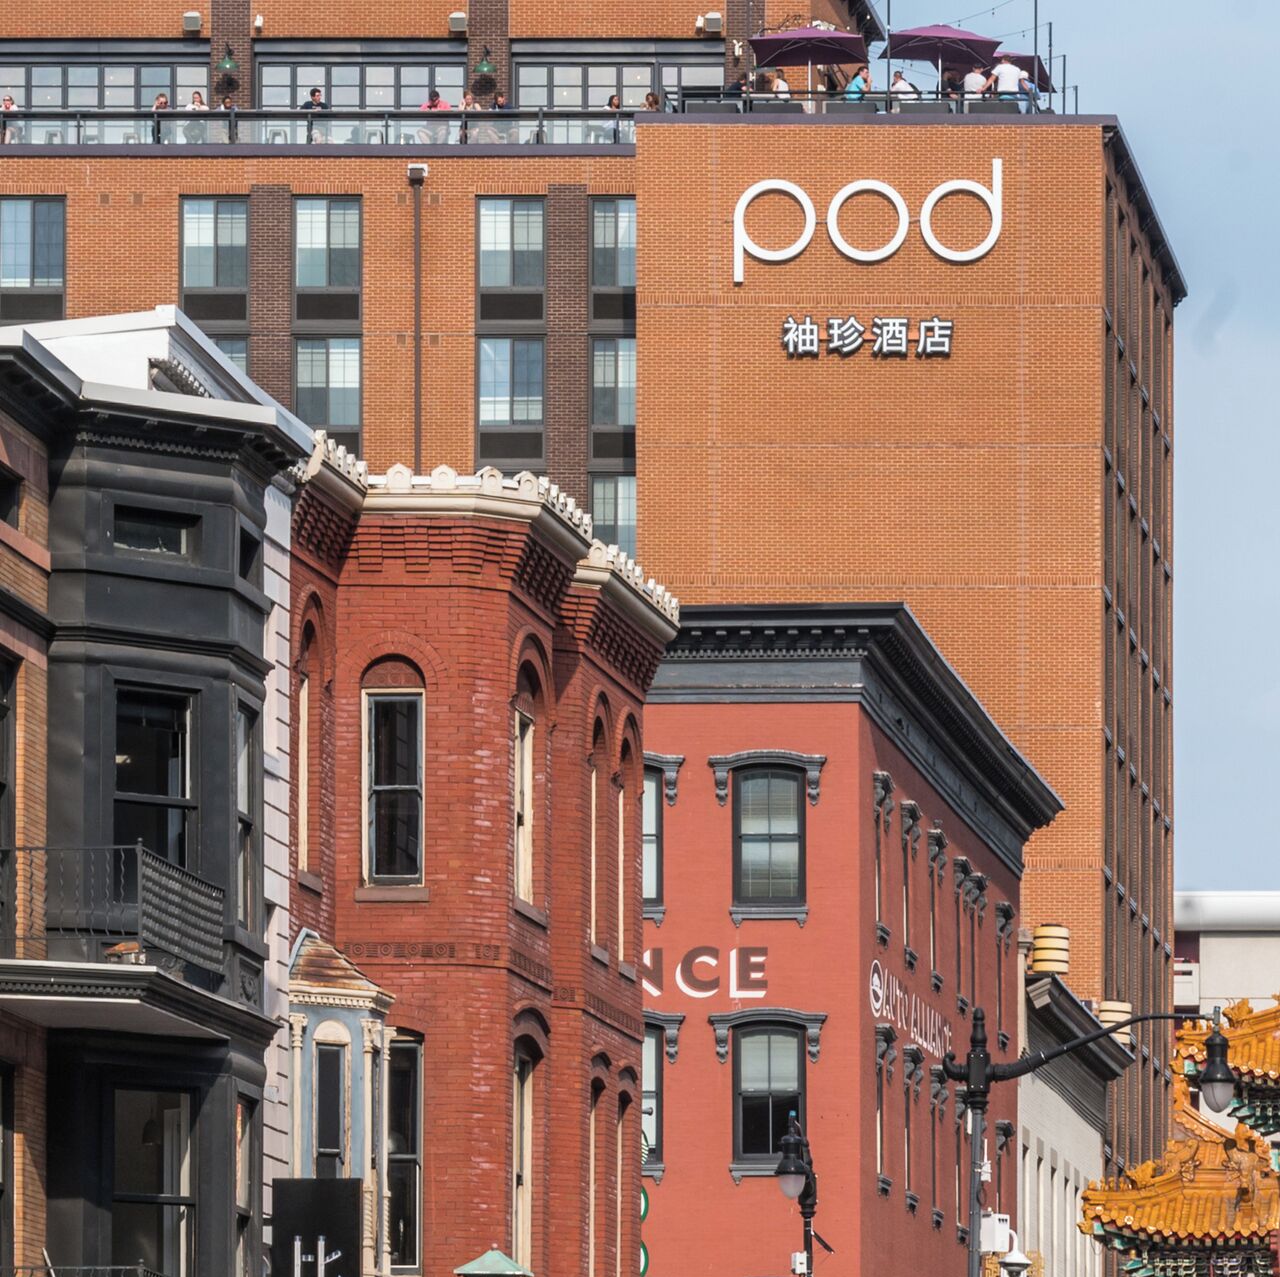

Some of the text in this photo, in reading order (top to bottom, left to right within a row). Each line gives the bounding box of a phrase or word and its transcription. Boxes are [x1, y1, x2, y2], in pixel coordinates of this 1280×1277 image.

[733, 158, 1003, 283] pod
[783, 315, 954, 357] 袖珍酒店
